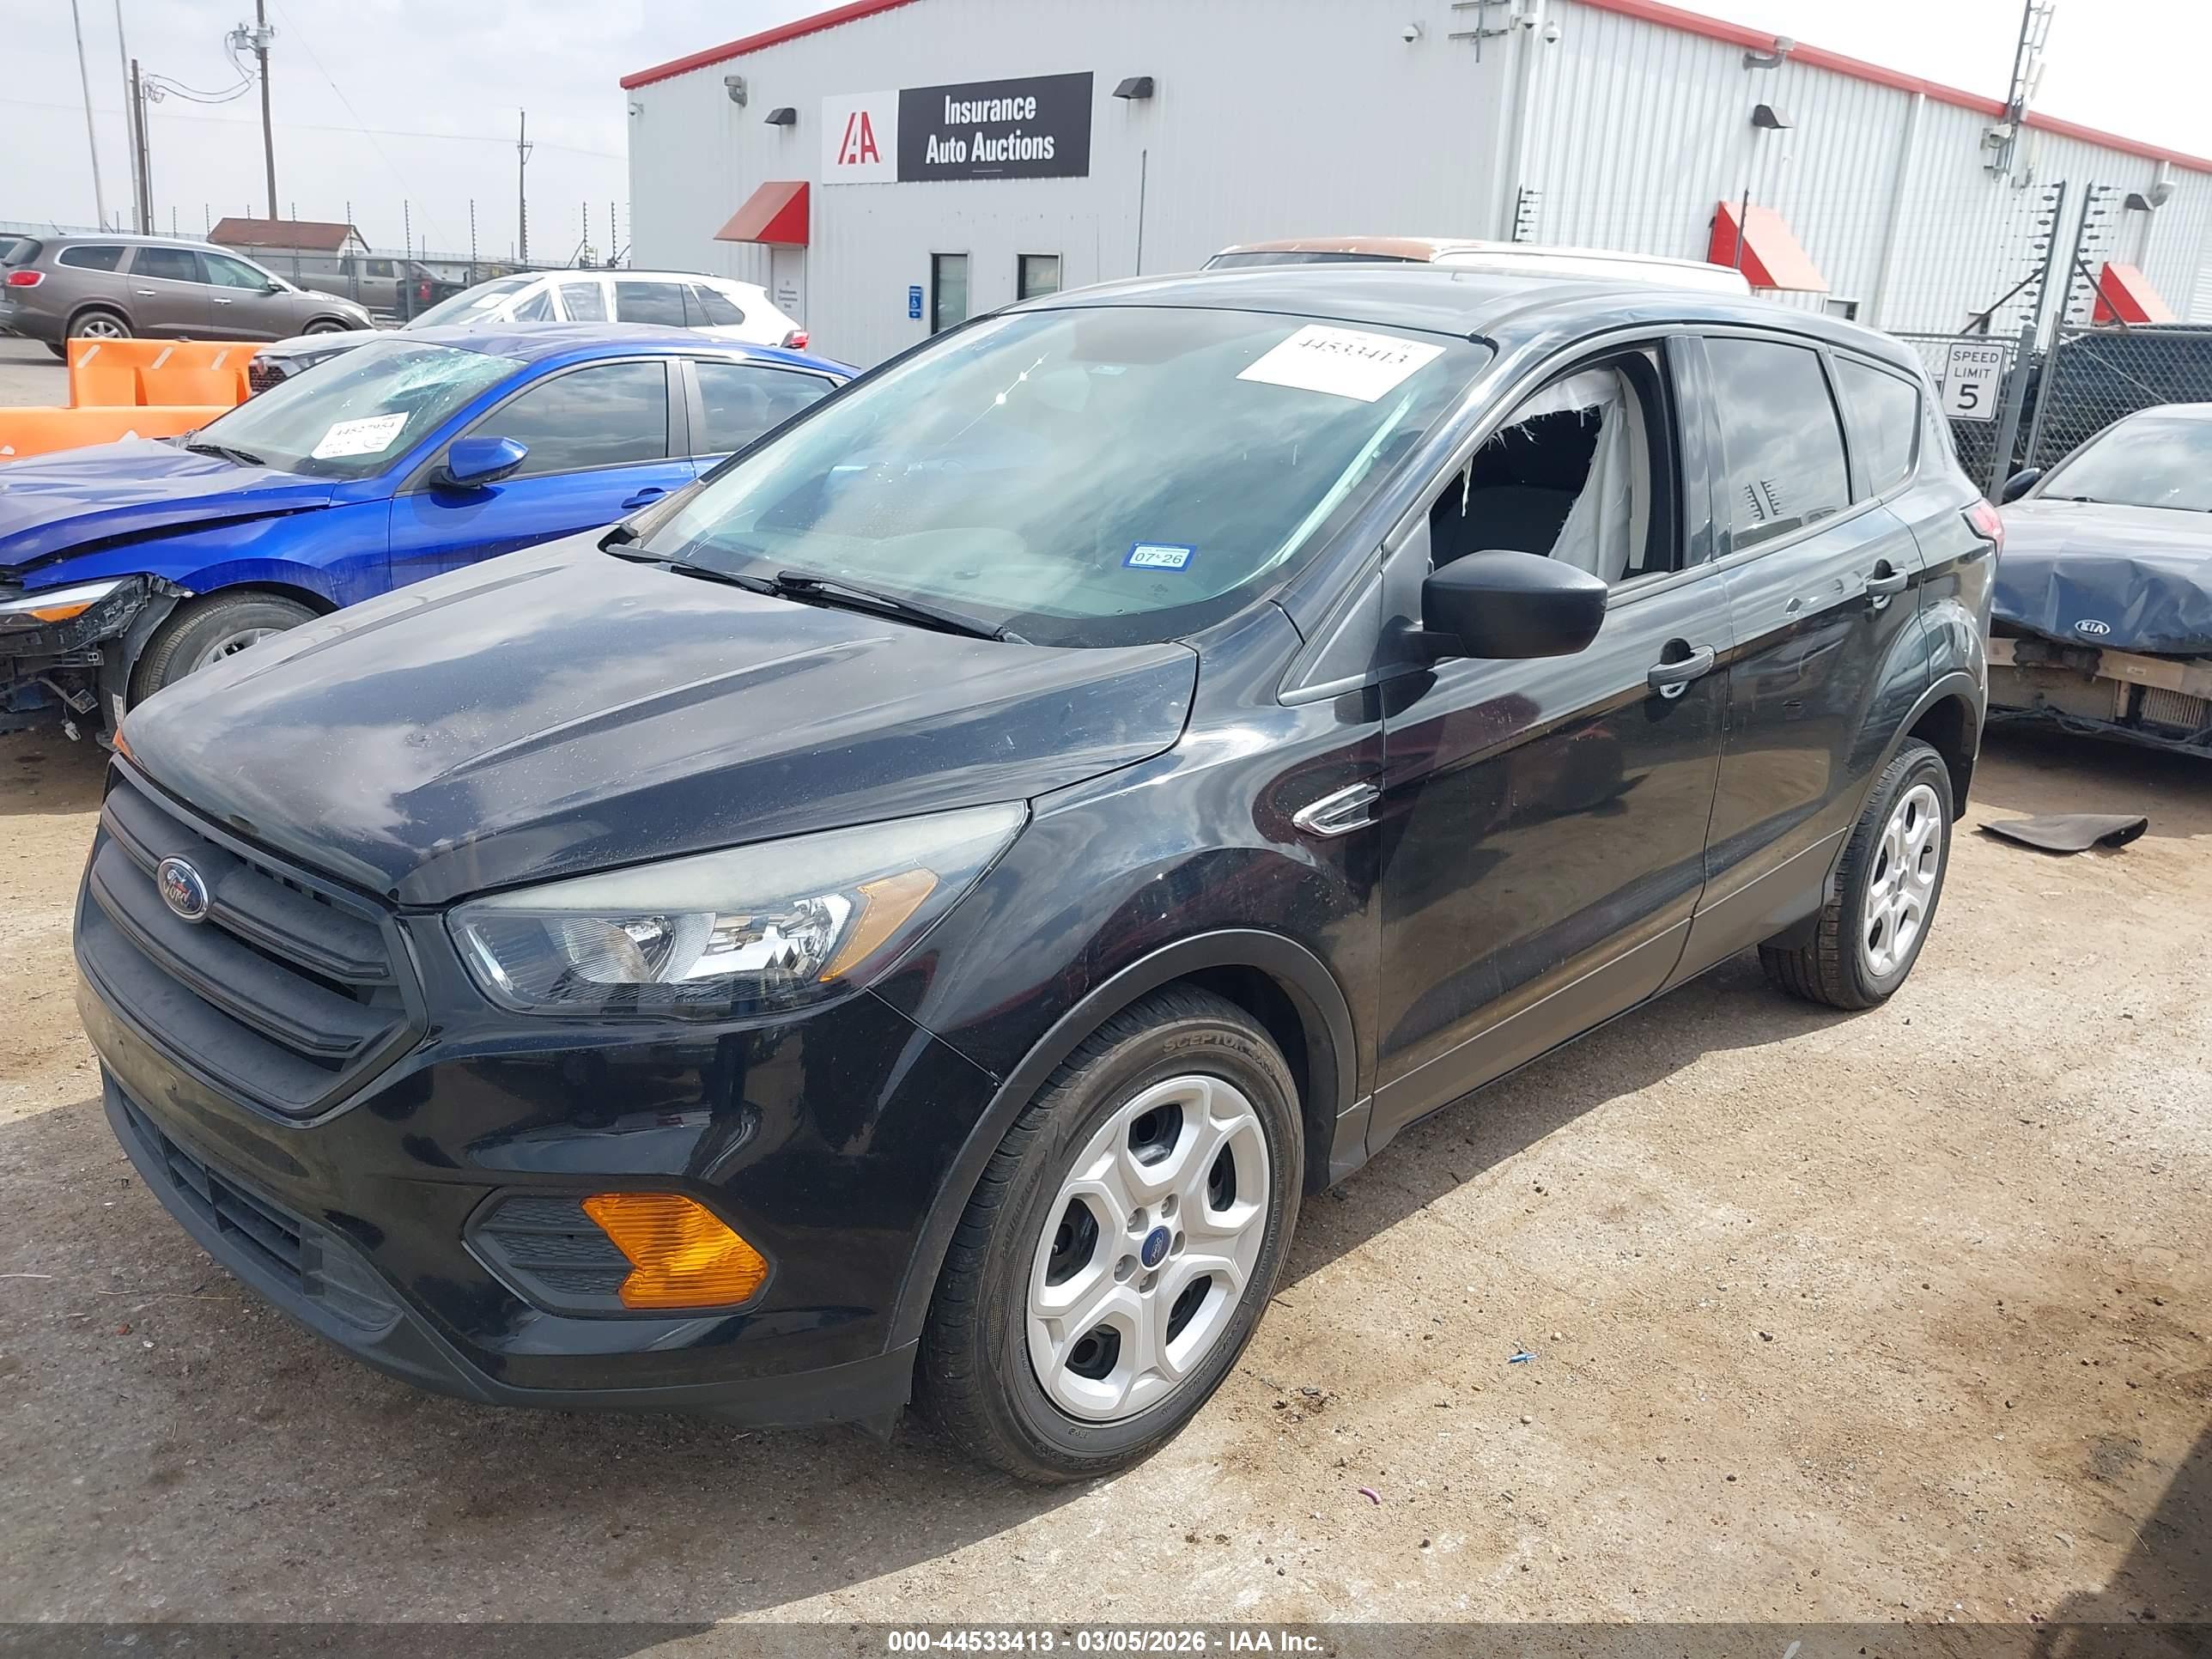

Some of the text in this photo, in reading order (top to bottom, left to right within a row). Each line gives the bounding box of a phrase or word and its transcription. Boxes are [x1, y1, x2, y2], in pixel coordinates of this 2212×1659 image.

[945, 94, 1036, 125] Insurance
[925, 129, 1055, 164] Auto Auctions
[1297, 338, 1408, 363] 44533413
[1953, 350, 1999, 363] SPEED
[1954, 367, 1991, 379] LIMIT
[1957, 384, 1978, 410] 5
[2080, 621, 2104, 634] KIA
